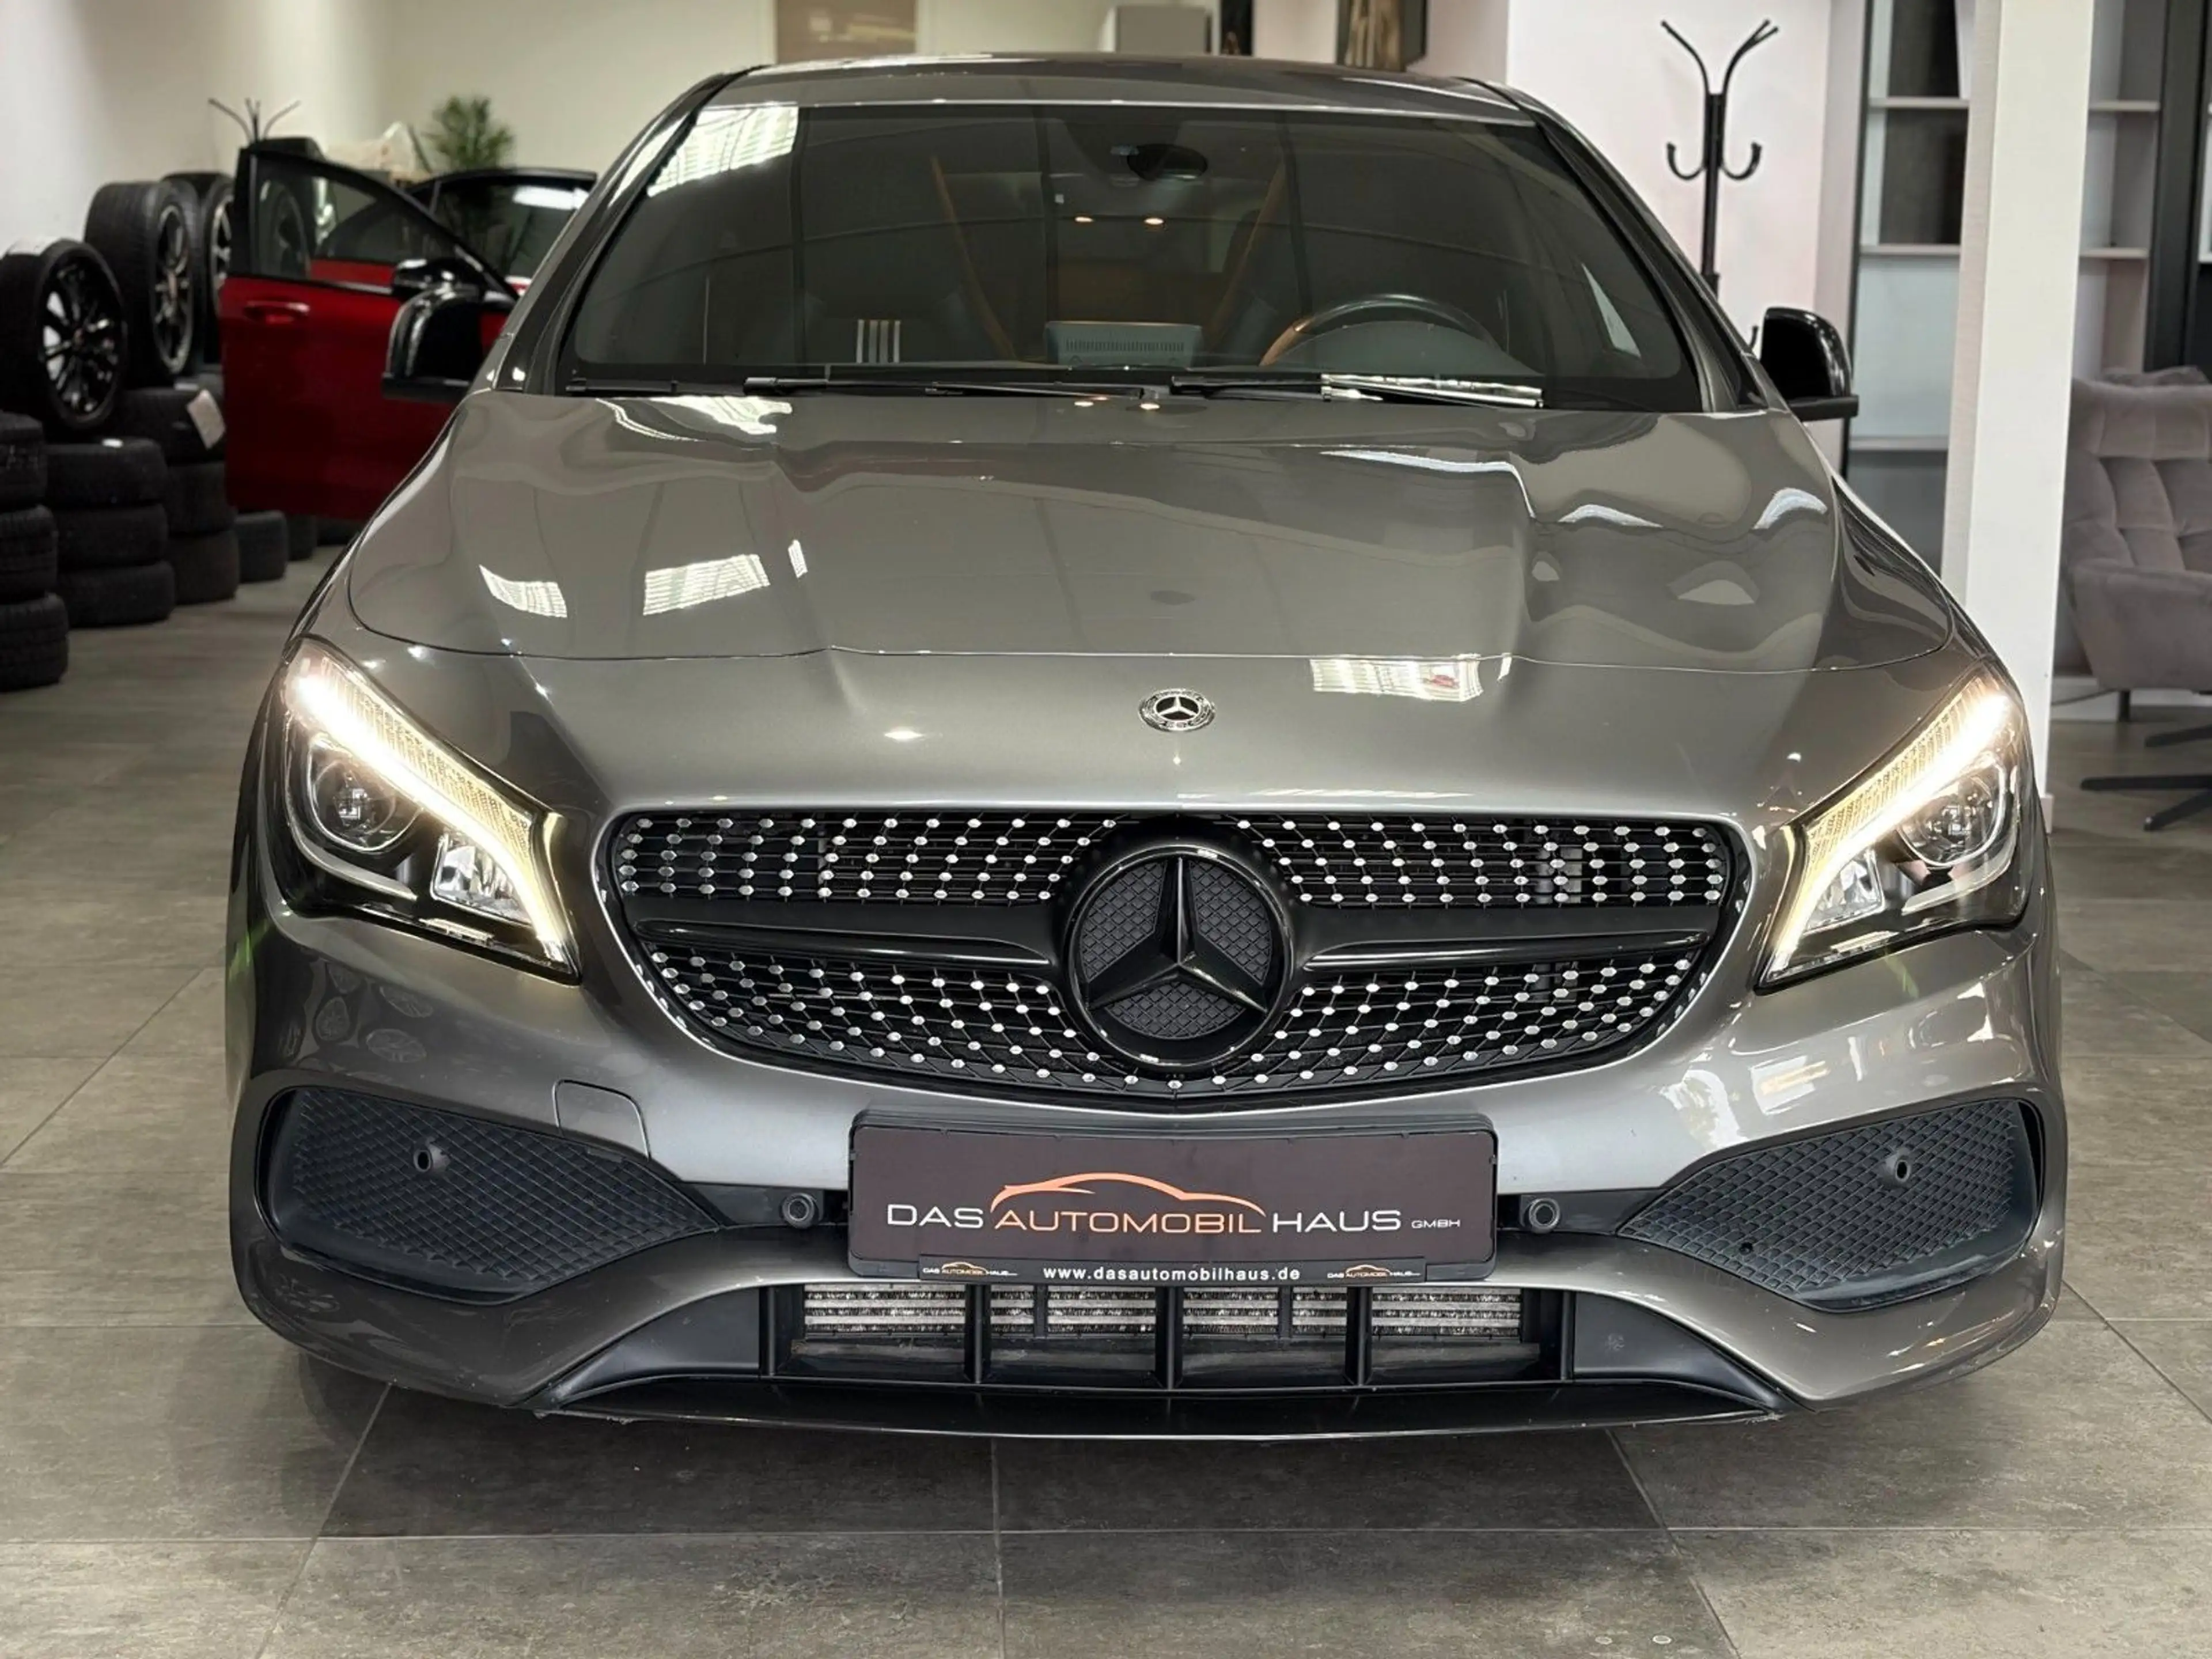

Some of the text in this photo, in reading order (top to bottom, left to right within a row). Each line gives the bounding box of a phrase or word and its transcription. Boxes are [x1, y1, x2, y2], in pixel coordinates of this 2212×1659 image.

[887, 1203, 1461, 1233] DAS AUTOMOBIL HAUS GMBH
[1043, 1266, 1300, 1281] www.dasautomobilhaus.de
